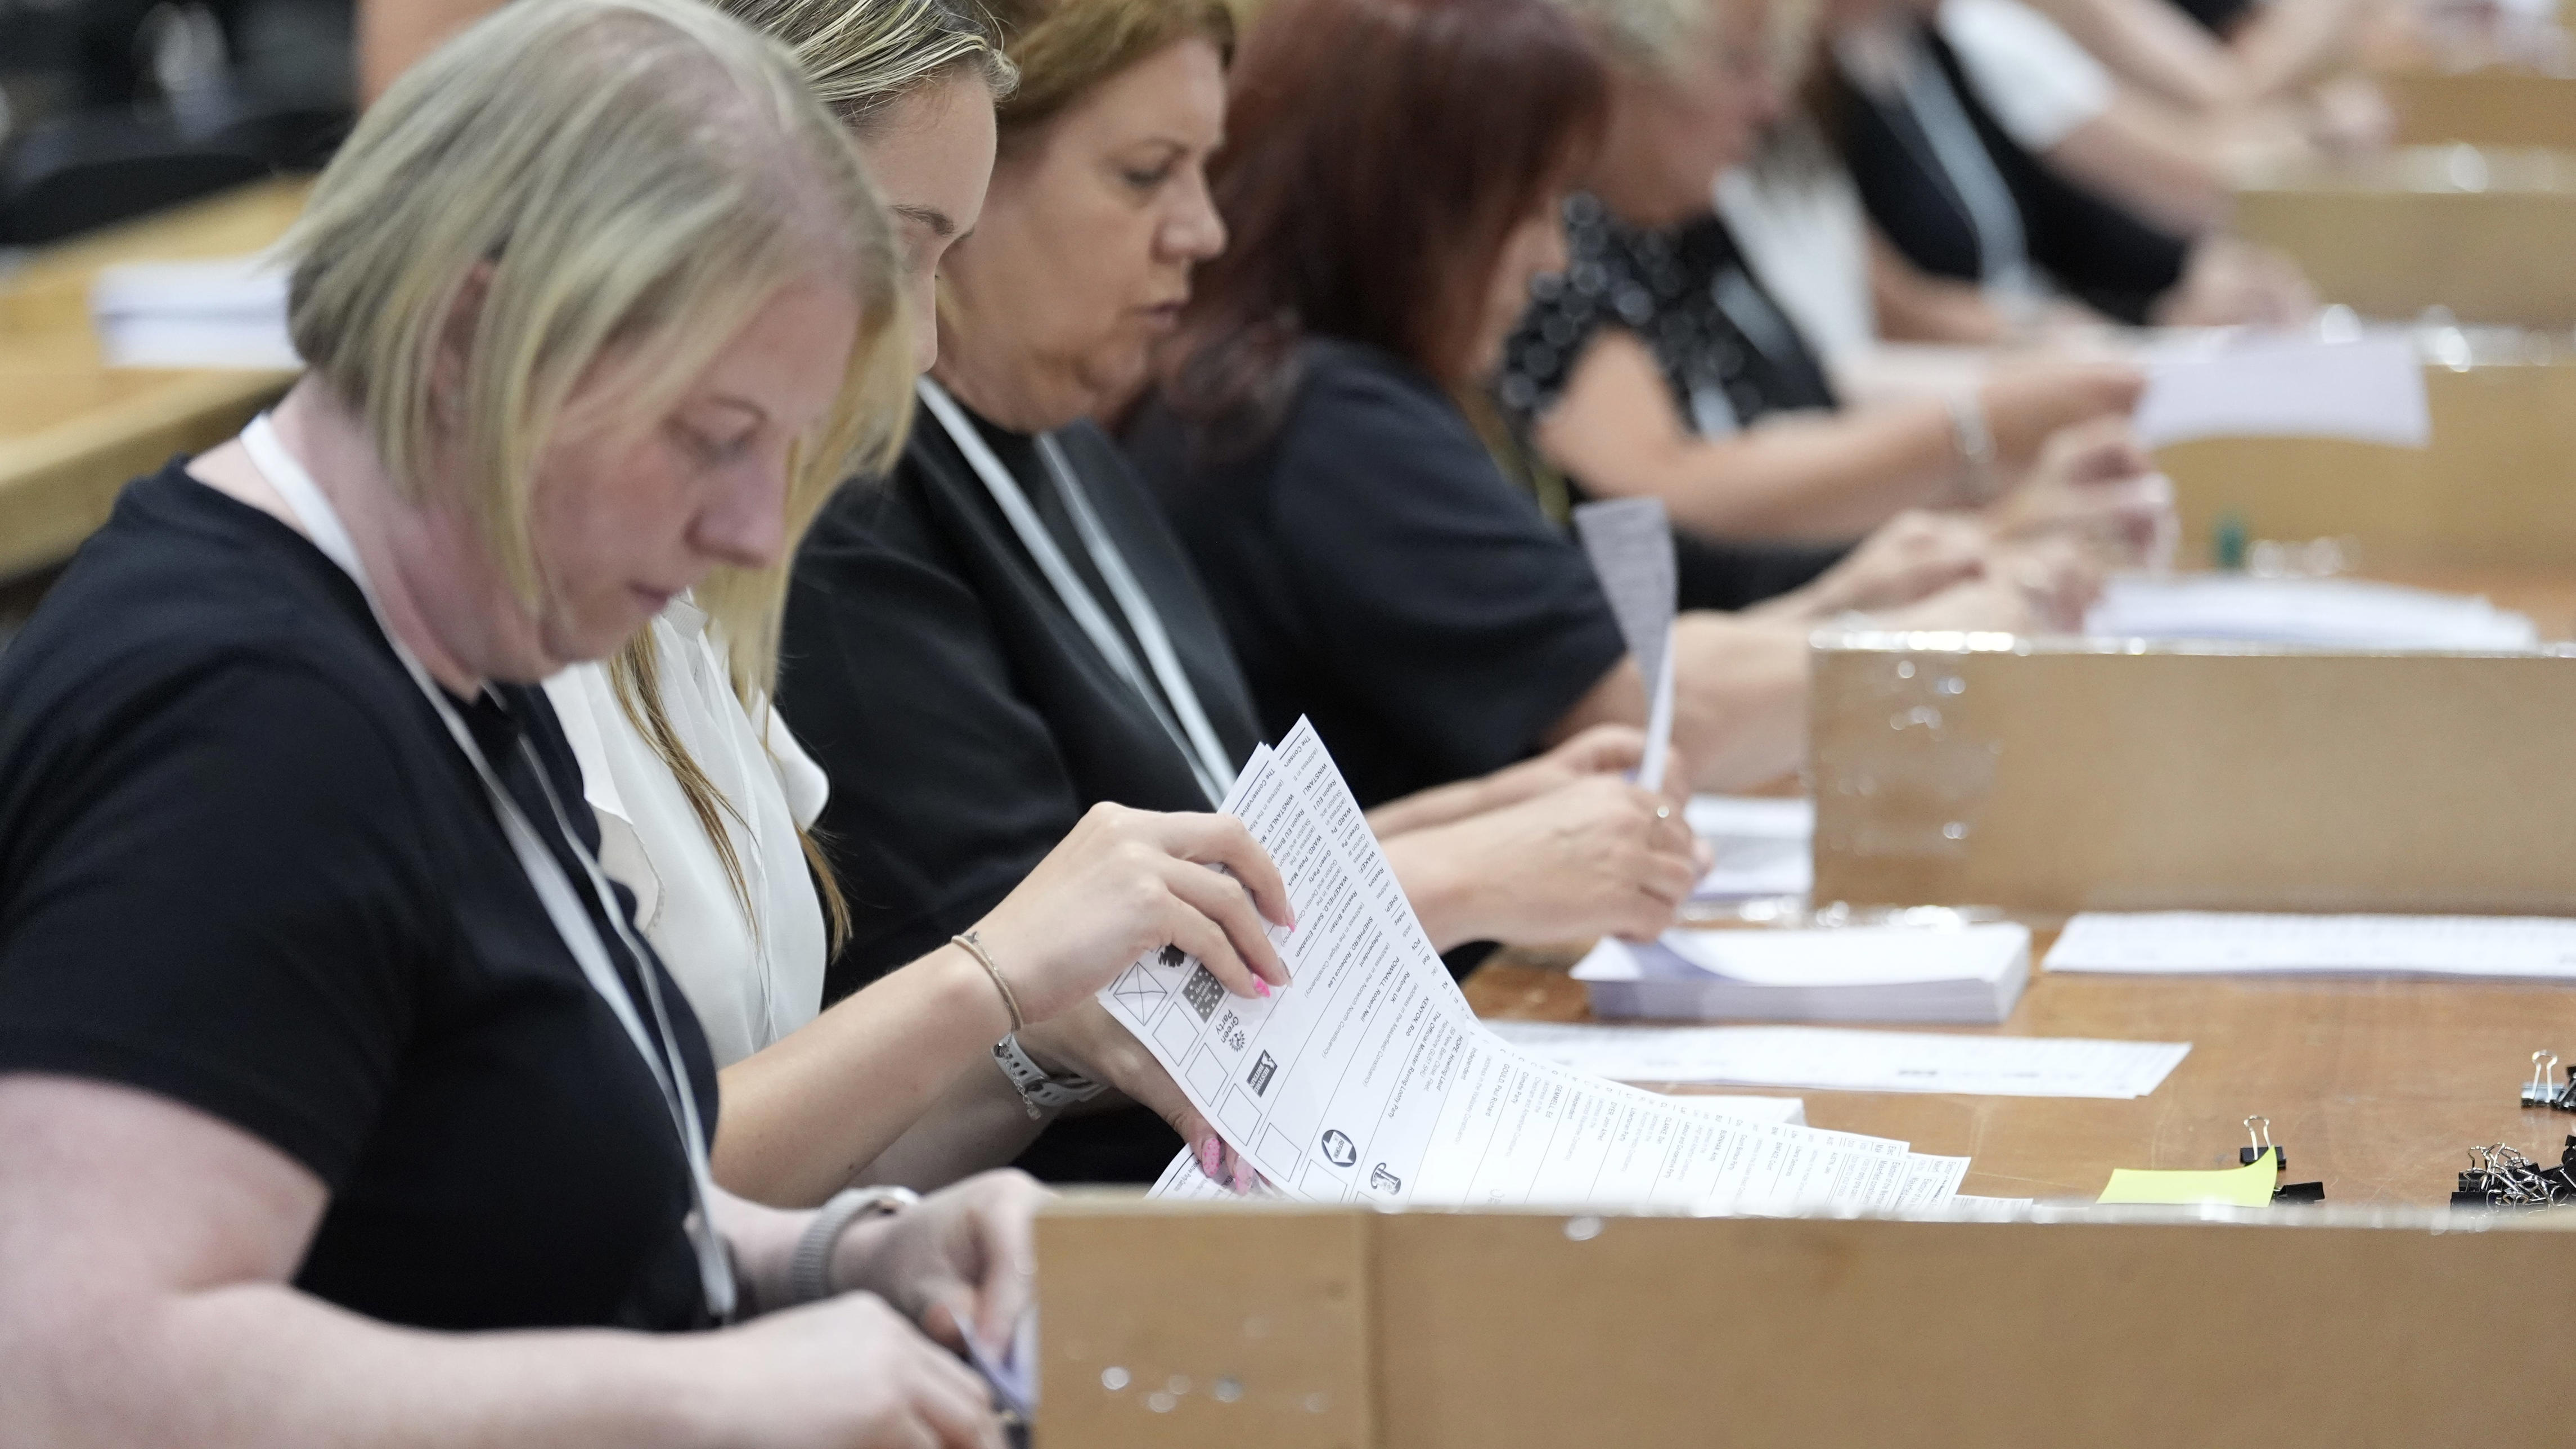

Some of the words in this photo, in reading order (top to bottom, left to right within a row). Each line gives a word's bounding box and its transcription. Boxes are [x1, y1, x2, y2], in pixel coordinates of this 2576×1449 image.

[1300, 735, 1311, 748] The
[1265, 768, 1275, 781] The
[1266, 778, 1284, 805] (address
[1321, 778, 1337, 798] Rejoin
[1239, 779, 1267, 818] Conservative
[1262, 803, 1269, 812] in
[1315, 796, 1324, 808] EU
[1326, 789, 1342, 810] Skipton
[1256, 809, 1265, 821] the
[1265, 793, 1294, 836] WINSTANLEY,
[1289, 808, 1305, 829] Rejoin
[1336, 807, 1352, 827] WARD,
[1284, 827, 1293, 839] EU
[1295, 817, 1311, 840] Skipton
[1298, 825, 1316, 852] (address
[1346, 823, 1360, 842] Green
[1273, 836, 1286, 856] Bring
[1288, 838, 1298, 852] and
[1307, 834, 1322, 856] WARD,
[1351, 833, 1366, 852] Gorton
[1277, 849, 1291, 868] Ripon
[1289, 856, 1297, 867] the
[1297, 855, 1309, 873] Peter
[1318, 849, 1332, 869] Green
[1287, 871, 1298, 888] Mark
[1307, 867, 1320, 885] Party
[1323, 859, 1338, 880] Gorton
[1325, 865, 1343, 892] (address
[1316, 878, 1325, 892] and
[1321, 890, 1328, 898] in
[1323, 875, 1348, 913] WAKEFIELD,
[1303, 889, 1319, 911] Denton
[1315, 896, 1324, 907] the
[1341, 890, 1357, 915] Restore
[1311, 912, 1324, 932] Sarah
[1329, 913, 1343, 935] Britain
[1347, 901, 1365, 928] (address
[1338, 933, 1346, 944] the
[1344, 926, 1350, 934] in
[1350, 916, 1373, 952] SHEPHERD,
[1294, 930, 1314, 958] Elizabeth
[1327, 942, 1341, 962] Wigan
[1358, 930, 1383, 968] Independent
[1334, 951, 1352, 978] Rebecca
[1374, 942, 1391, 968] (address
[1303, 960, 1329, 1000] Constituency)
[1379, 956, 1400, 988] POWNALL,
[1395, 971, 1410, 993] Reform
[1327, 976, 1337, 989] Lee
[1351, 982, 1367, 1006] Norwich
[1366, 988, 1381, 1010] Robert
[1390, 992, 1398, 1004] UK
[1403, 982, 1419, 1008] (address
[1342, 1005, 1354, 1022] North
[1360, 1008, 1369, 1023] Neil
[1412, 996, 1429, 1024] KENYON,
[1432, 1011, 1441, 1023] The
[1215, 1009, 1234, 1036] Party
[1220, 1015, 1240, 1044] Green
[1405, 1023, 1415, 1037] Rob
[1449, 1026, 1456, 1036] 59
[1380, 1022, 1398, 1052] Makerfield
[1422, 1022, 1435, 1044] Official
[1431, 1019, 1450, 1049] Hampshire
[1443, 1034, 1453, 1047] New
[1437, 1046, 1447, 1061] Barn
[1451, 1034, 1463, 1054] HOPE,
[1411, 1042, 1425, 1067] Monster
[1441, 1052, 1455, 1077] Howling
[1460, 1047, 1478, 1081] Independent
[1248, 1063, 1265, 1089] BRITAIN
[1253, 1066, 1271, 1094] RESTORE
[1401, 1065, 1414, 1087] Raving
[1436, 1075, 1445, 1092] Laud
[1517, 1071, 1530, 1091] Climate
[1393, 1085, 1405, 1105] Loony
[1492, 1084, 1503, 1097] Paul
[1510, 1091, 1522, 1104] Party
[1387, 1102, 1398, 1119] Party
[1485, 1096, 1498, 1117] Richard
[1566, 1091, 1583, 1120] Independent
[1332, 1138, 1345, 1159] REFORM
[1887, 1162, 1900, 1178] Election
